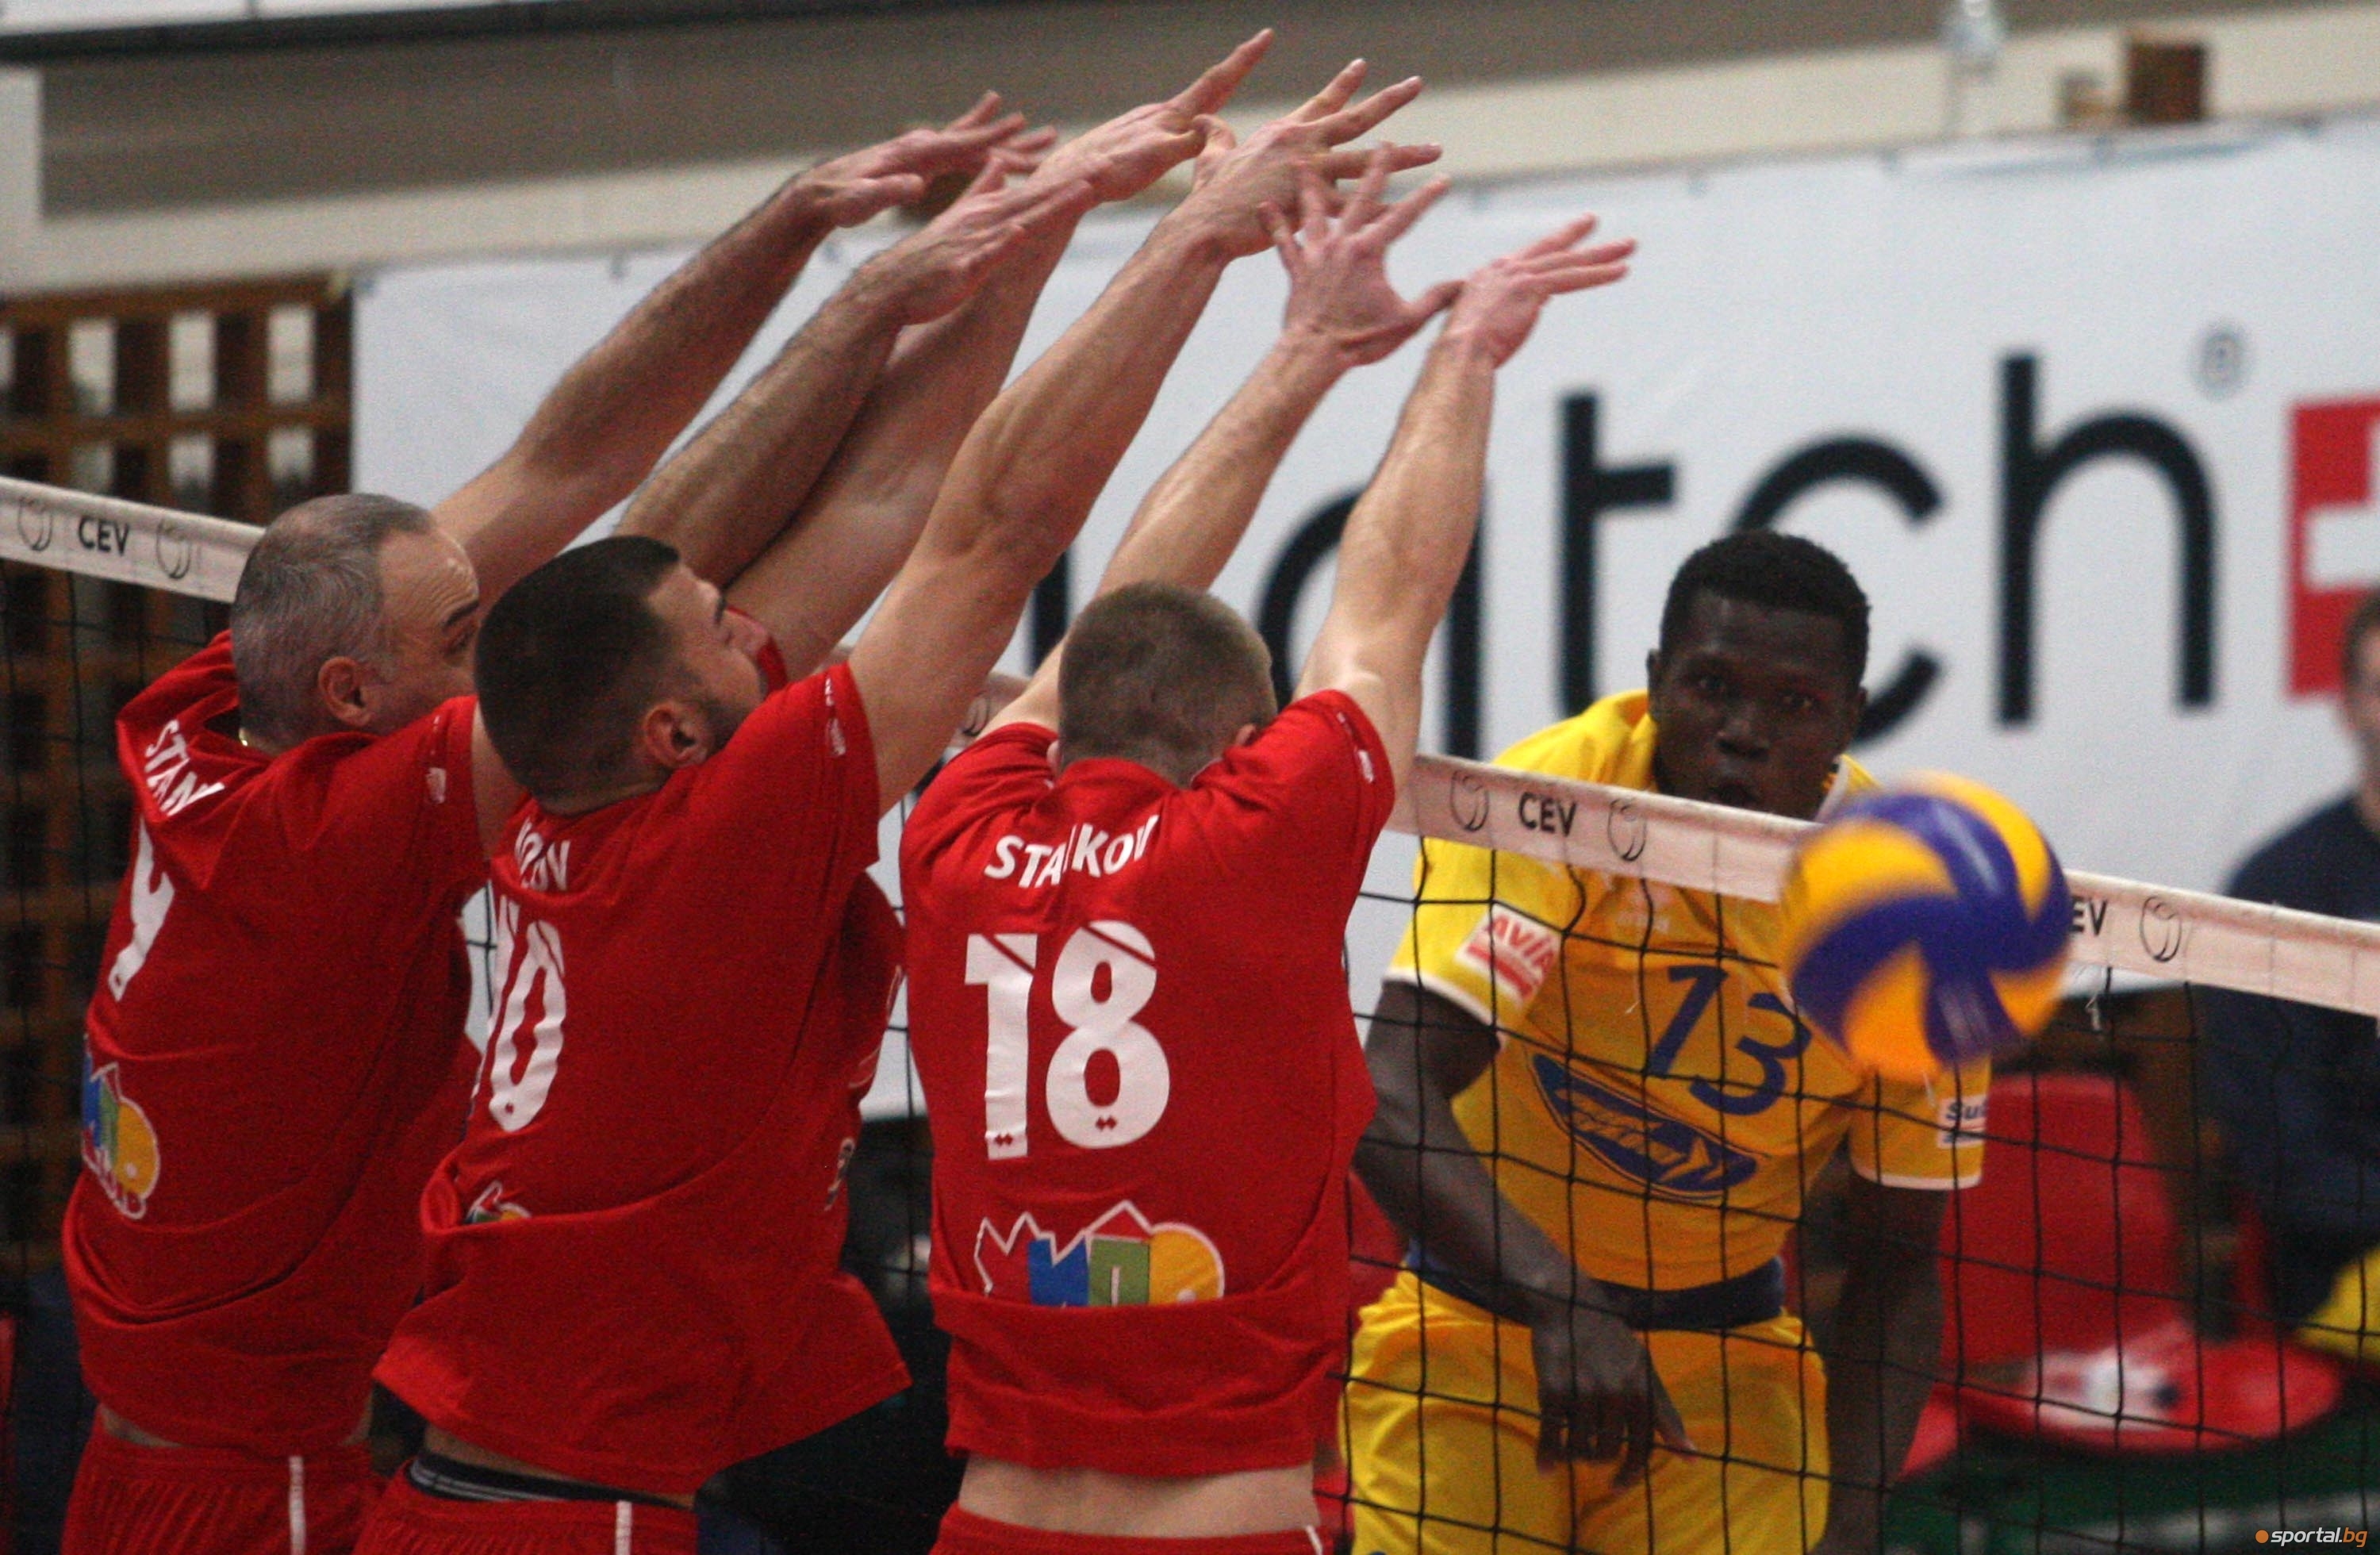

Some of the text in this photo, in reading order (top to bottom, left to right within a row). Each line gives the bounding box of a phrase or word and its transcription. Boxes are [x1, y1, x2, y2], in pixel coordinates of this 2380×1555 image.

[78, 516, 131, 556] CEV
[1029, 351, 2219, 762] atch
[1518, 792, 1577, 837] CEV
[984, 814, 1160, 889] STAKOV
[1484, 914, 1554, 973] AVIA
[2071, 895, 2109, 937] EV
[965, 920, 1171, 1161] 18
[1644, 965, 1813, 1115] 13
